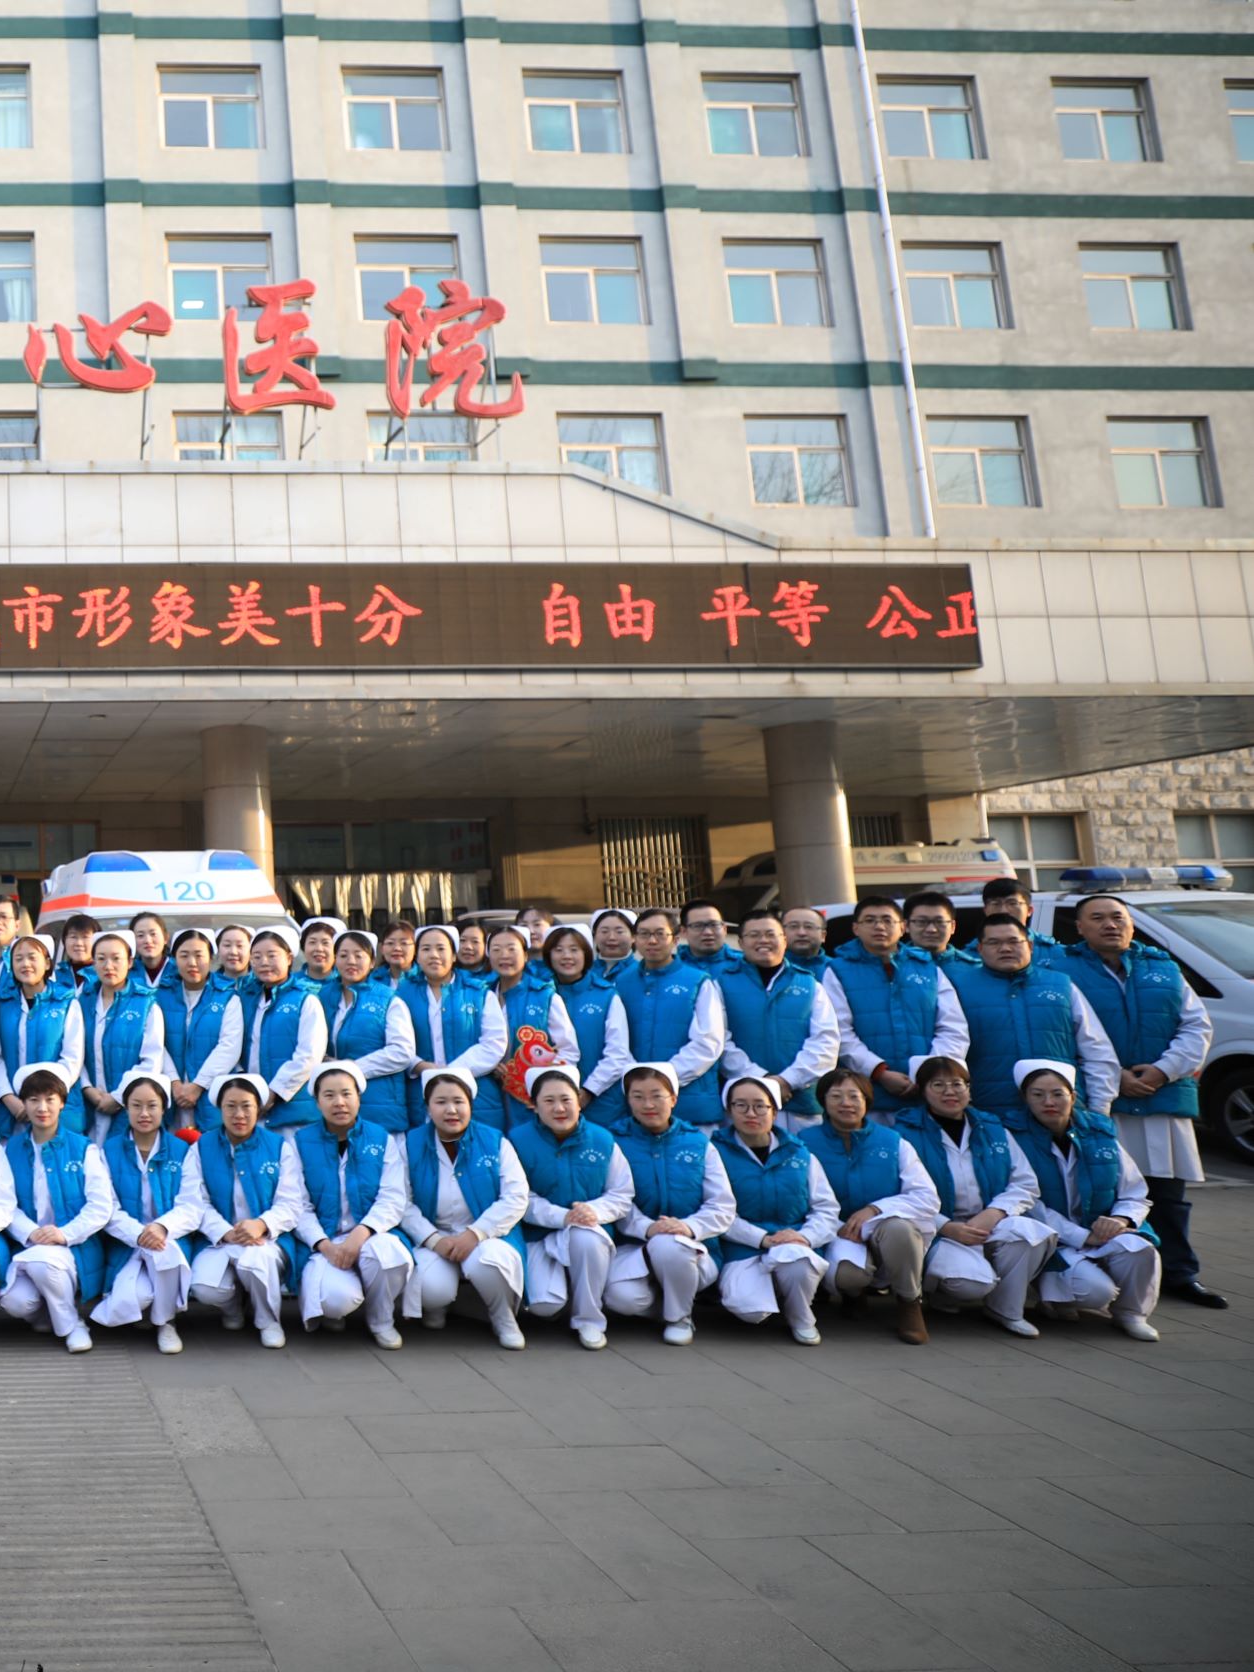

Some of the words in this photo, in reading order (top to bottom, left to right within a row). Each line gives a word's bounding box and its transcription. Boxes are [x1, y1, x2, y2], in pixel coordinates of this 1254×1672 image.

[541, 582, 657, 649] 自由
[700, 579, 831, 648] 平等
[154, 881, 215, 901] 120
